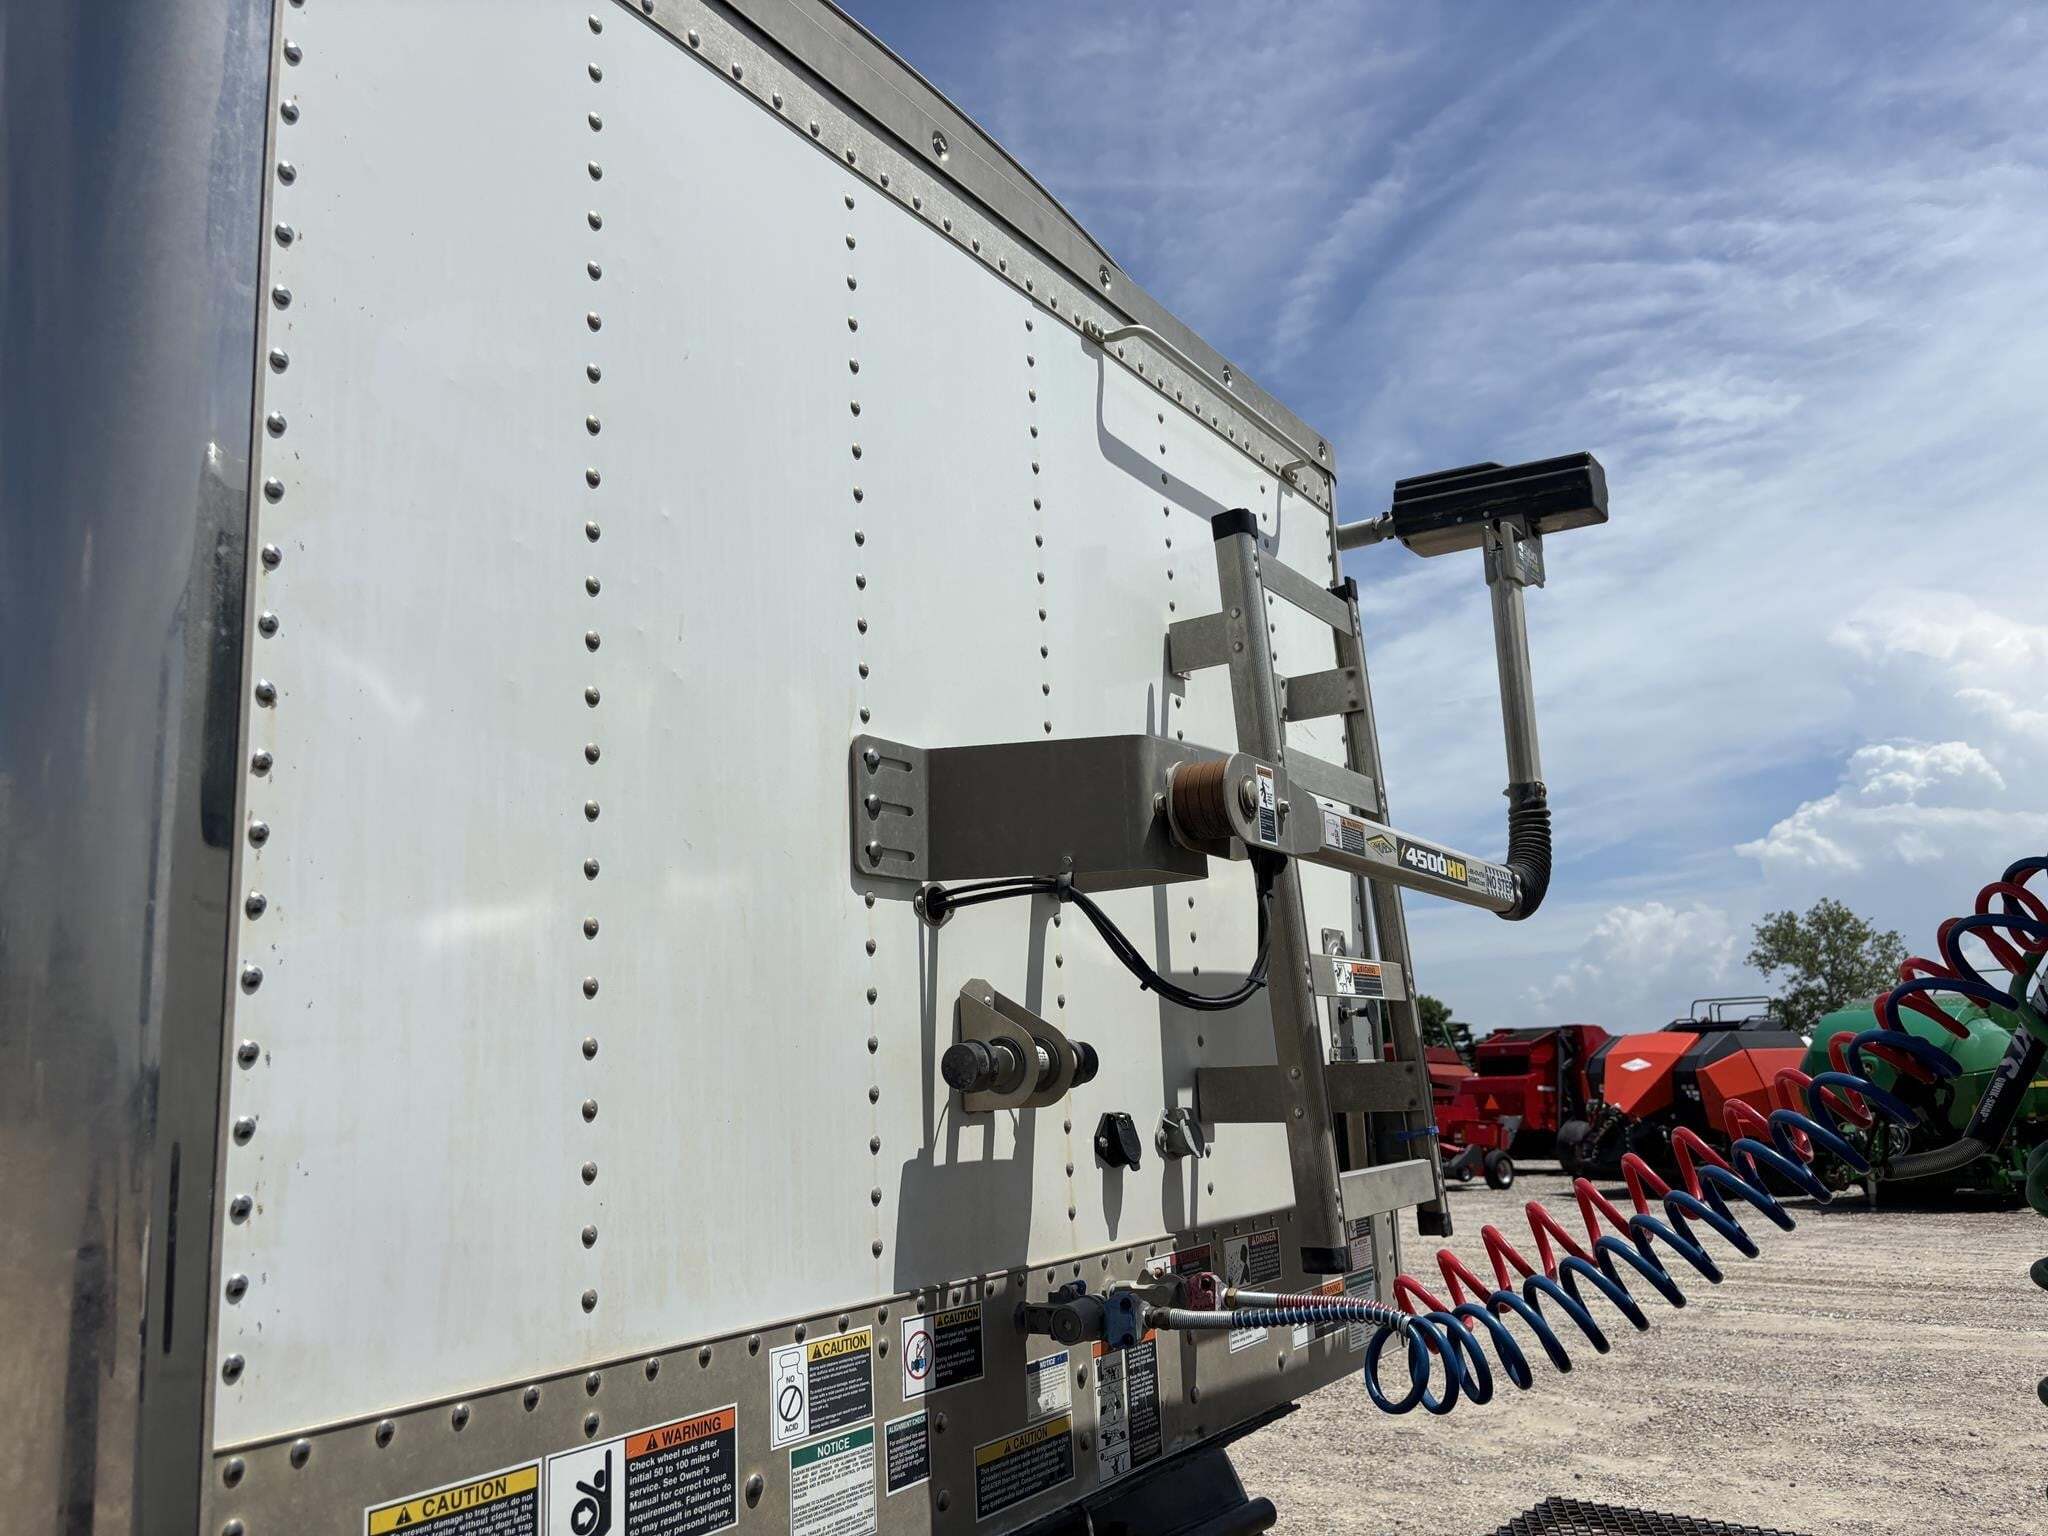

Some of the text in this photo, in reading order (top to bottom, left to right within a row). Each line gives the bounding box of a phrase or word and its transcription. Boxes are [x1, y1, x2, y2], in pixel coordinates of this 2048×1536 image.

[1406, 847, 1466, 881] 4500HD
[1486, 872, 1500, 889] NO
[1499, 876, 1514, 893] STEP
[943, 1304, 979, 1324] CAUTION
[822, 1333, 868, 1354] CAUTION
[785, 1375, 796, 1385] NO
[661, 1416, 721, 1447] WARNING
[785, 1422, 799, 1434] ACID
[1013, 1425, 1048, 1450] CAUTION
[630, 1439, 718, 1472] Check wheel nuts after
[817, 1436, 851, 1458] NOTICE
[630, 1448, 720, 1486] initial 50 to 100 miles of
[630, 1465, 710, 1499] service. See Owner's
[630, 1472, 727, 1511] Manual for correct torque
[422, 1477, 507, 1518] CAUTION
[433, 1514, 464, 1530] damage
[465, 1509, 474, 1520] to
[475, 1506, 490, 1518] trap
[510, 1496, 521, 1506] do
[522, 1492, 533, 1503] not
[630, 1482, 732, 1524] requirements. Failure to do
[459, 1516, 488, 1531] without
[491, 1507, 519, 1522] closing
[522, 1503, 534, 1513] the
[479, 1524, 494, 1536] trap
[495, 1518, 512, 1530] door
[504, 1521, 533, 1536] the trap
[630, 1493, 732, 1536] so may result in equipment
[674, 1514, 707, 1536] personal
[709, 1508, 731, 1523] injury.
